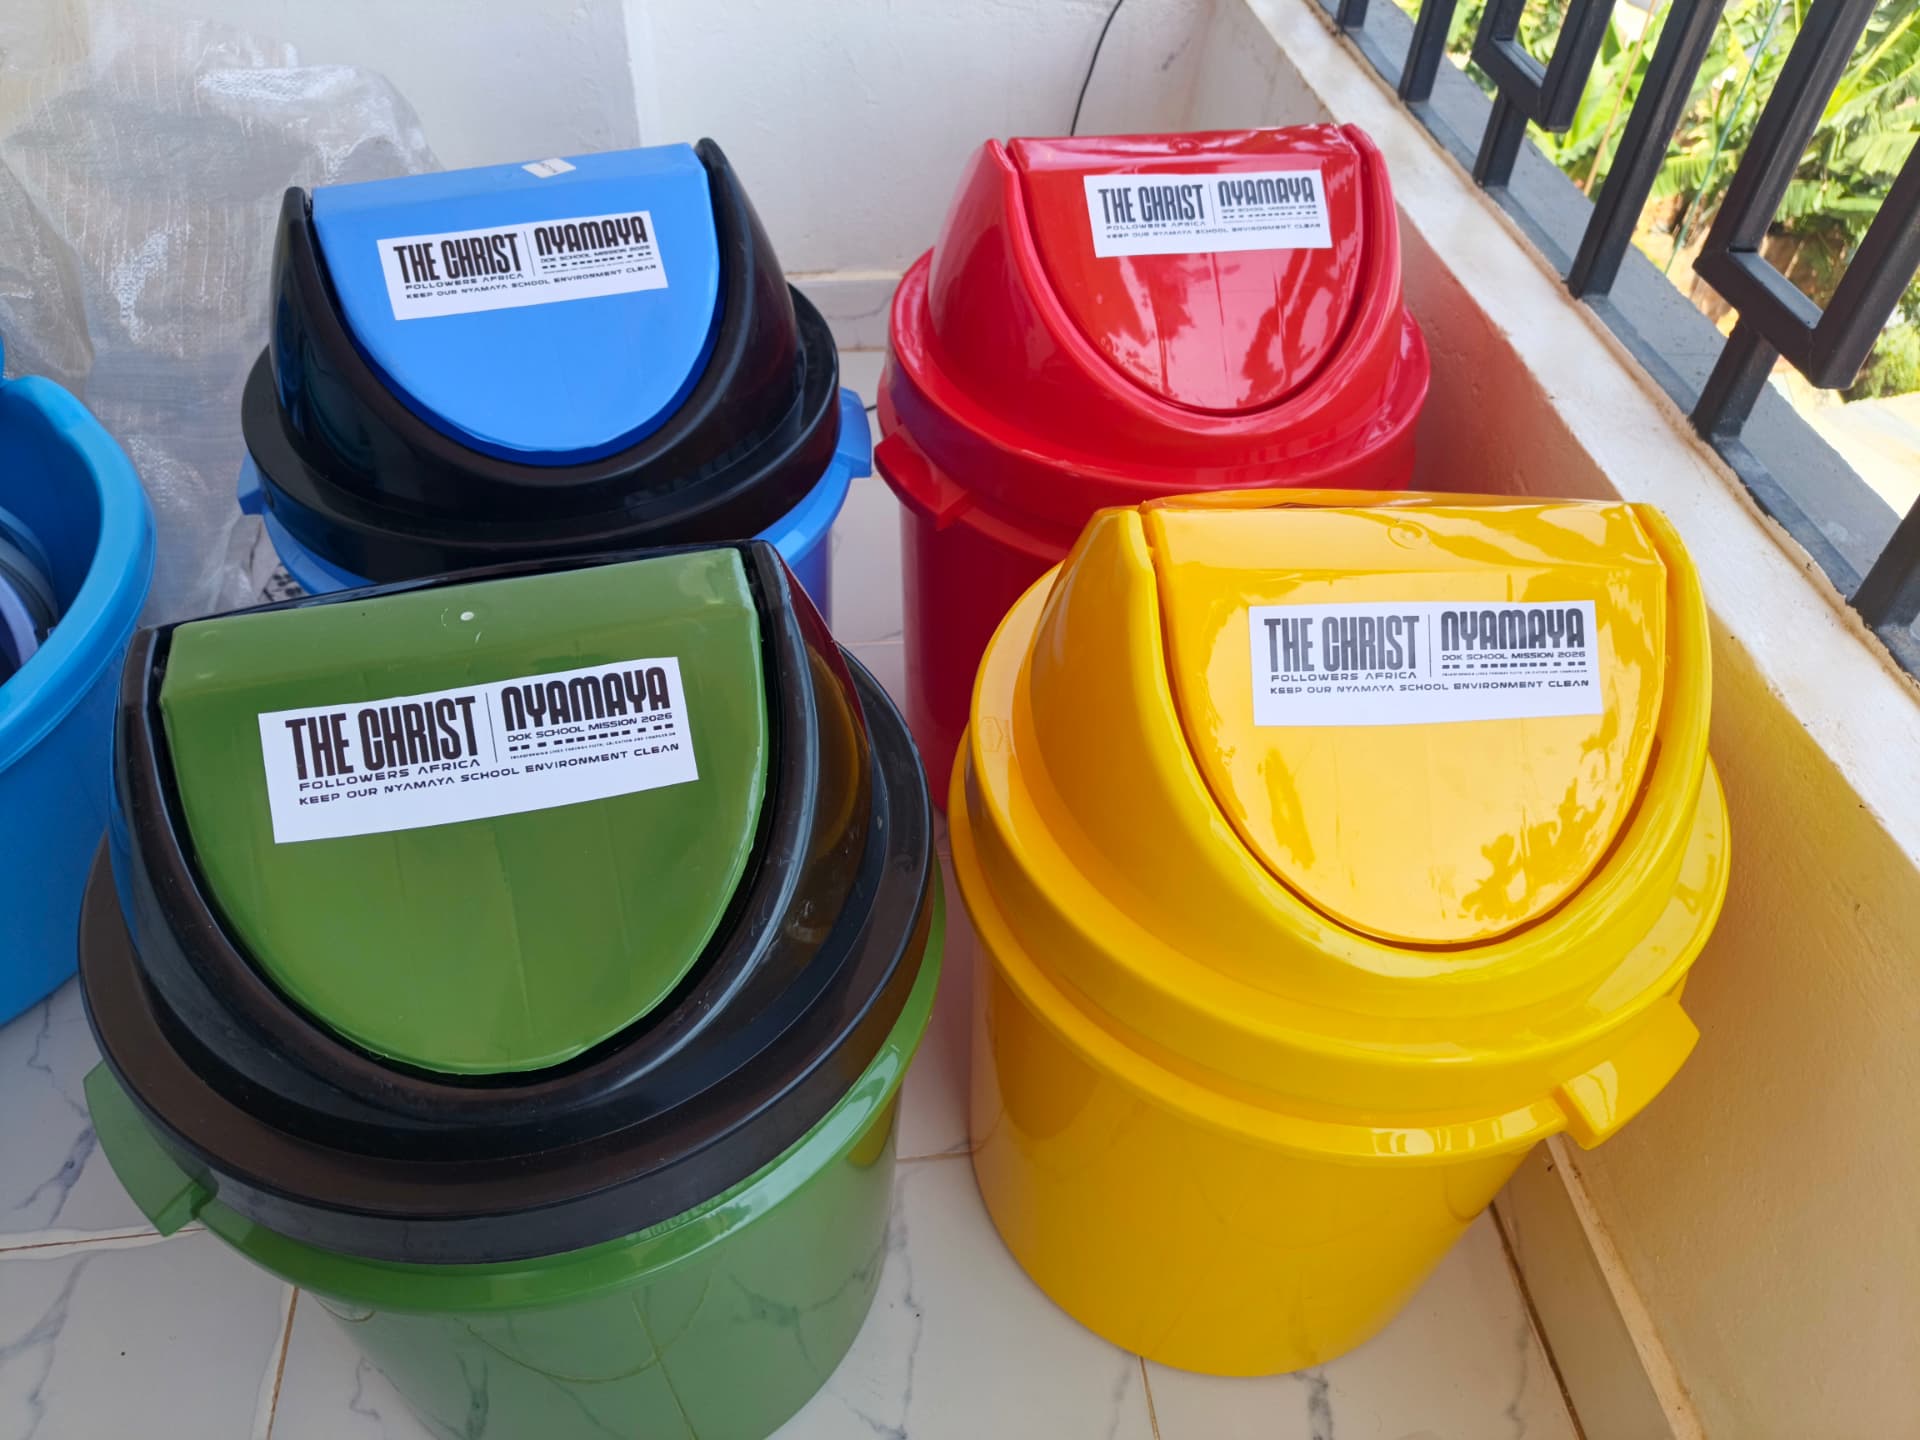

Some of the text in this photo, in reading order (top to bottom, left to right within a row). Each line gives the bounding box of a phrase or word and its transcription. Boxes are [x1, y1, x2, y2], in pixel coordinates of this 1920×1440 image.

[1098, 184, 1204, 224] THE CHRIST
[1218, 177, 1315, 207] NYAMAYA
[534, 216, 648, 256] NYAMAYA
[393, 233, 521, 283] THE CHRIST
[405, 273, 524, 290] FOLLOWERS AFRICA
[461, 284, 508, 294] NYAMAYA
[512, 280, 550, 288] SCHOOL
[554, 269, 622, 283] ENVIRONMENT
[626, 264, 657, 273] CLEAN
[1264, 615, 1420, 672] THE CHRIST
[1441, 608, 1585, 651] NYAMAYA
[1271, 672, 1417, 682] FOLLOWERS AFRICA
[1307, 686, 1332, 694] OUR
[1337, 685, 1394, 693] NYAMAYA
[1400, 683, 1448, 691] SCHOOL
[1453, 681, 1543, 690] ENVIRONMENT
[501, 667, 671, 731] NYAMAYA
[285, 696, 478, 780] THE CHRIST
[507, 713, 672, 742] DOK SCHOOL MISSION 2026
[299, 793, 340, 805] KEEP
[346, 787, 378, 799] OUR
[384, 777, 455, 793] NYAMAYA
[461, 767, 519, 783] SCHOOL
[525, 751, 628, 773] ENVIRONMENT
[634, 743, 679, 756] CLEAN
[299, 759, 480, 791] FOLLOWERS AFRICA
